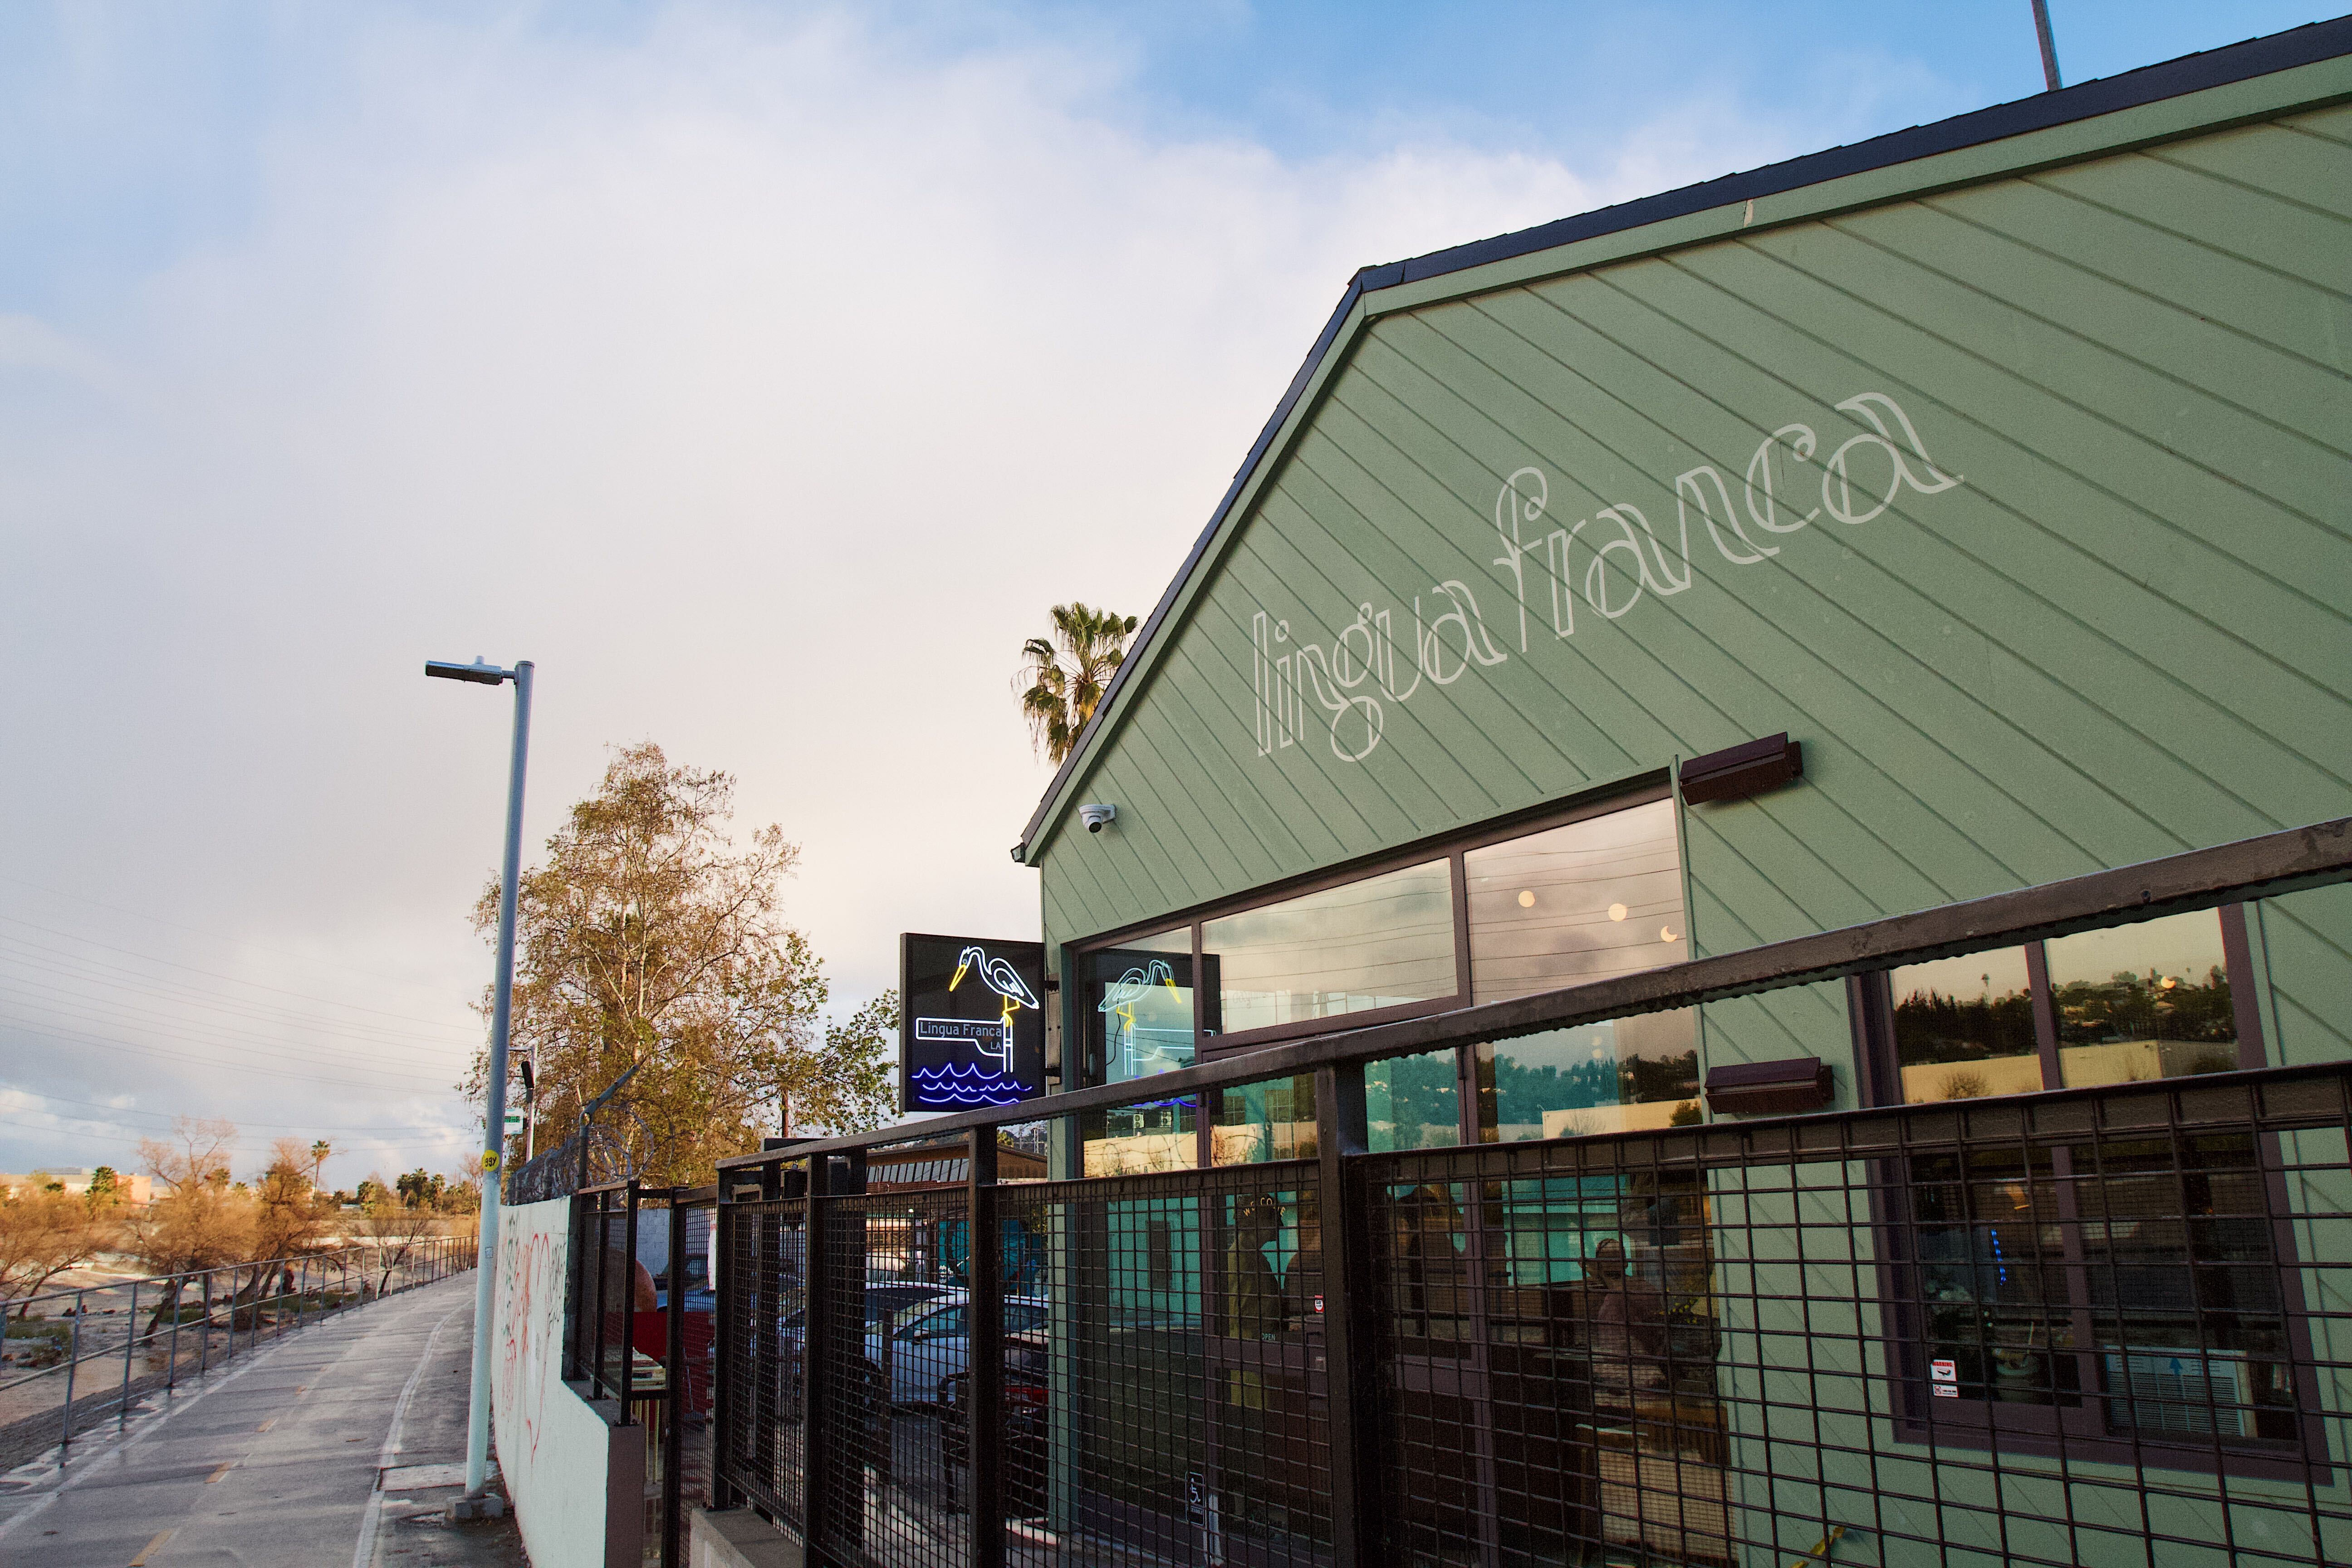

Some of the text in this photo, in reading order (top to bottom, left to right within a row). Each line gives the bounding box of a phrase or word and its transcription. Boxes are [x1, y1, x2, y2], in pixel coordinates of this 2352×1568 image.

[1253, 392, 1964, 763] lingua franca
[920, 1021, 1002, 1038] Lingua Franca
[990, 1041, 1001, 1050] LA
[1243, 1197, 1286, 1217] WECOE
